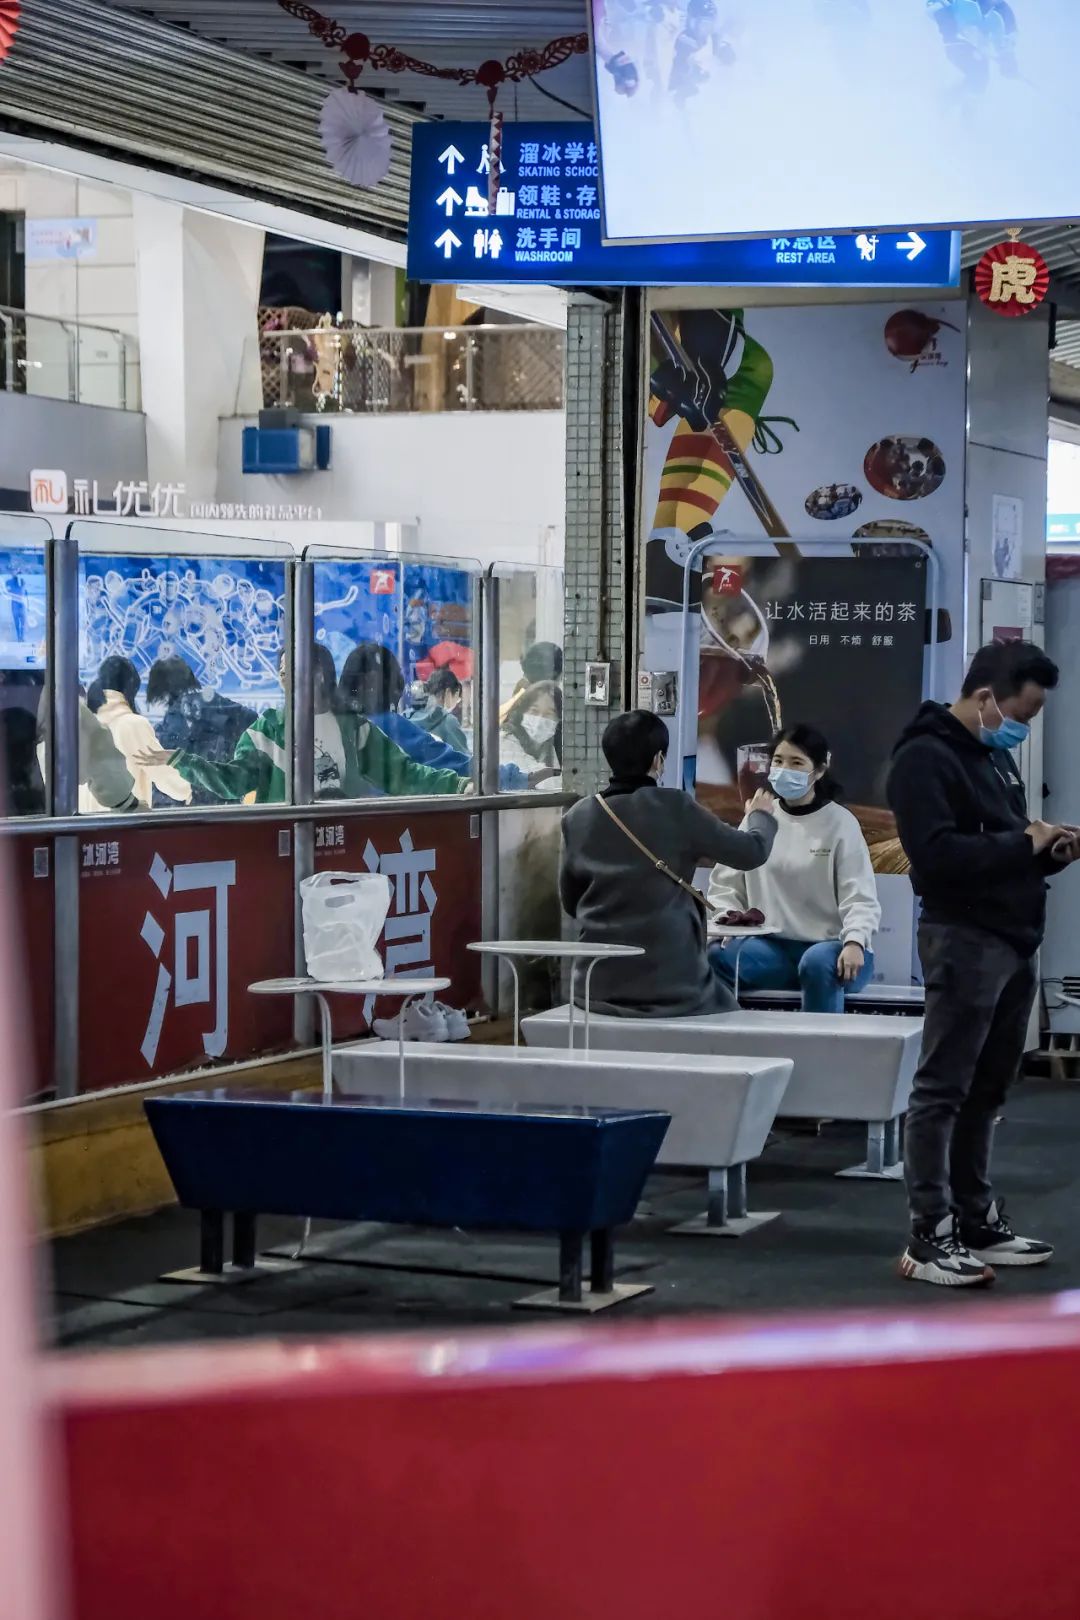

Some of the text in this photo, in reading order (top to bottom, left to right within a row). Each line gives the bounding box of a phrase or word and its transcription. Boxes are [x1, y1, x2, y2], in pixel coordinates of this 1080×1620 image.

[518, 166, 560, 177] SKATING
[516, 208, 551, 219] RENTAL
[555, 209, 561, 219] &
[516, 227, 581, 249] 洗手间
[515, 251, 573, 262] WASHROOM
[776, 252, 836, 263] REST AREA
[989, 255, 1036, 304] 虎
[73, 479, 186, 517] 礼优优
[765, 601, 917, 622] 让水活起来的茶
[809, 635, 894, 646] 日用 不烦 舒服
[140, 851, 236, 1069] 河
